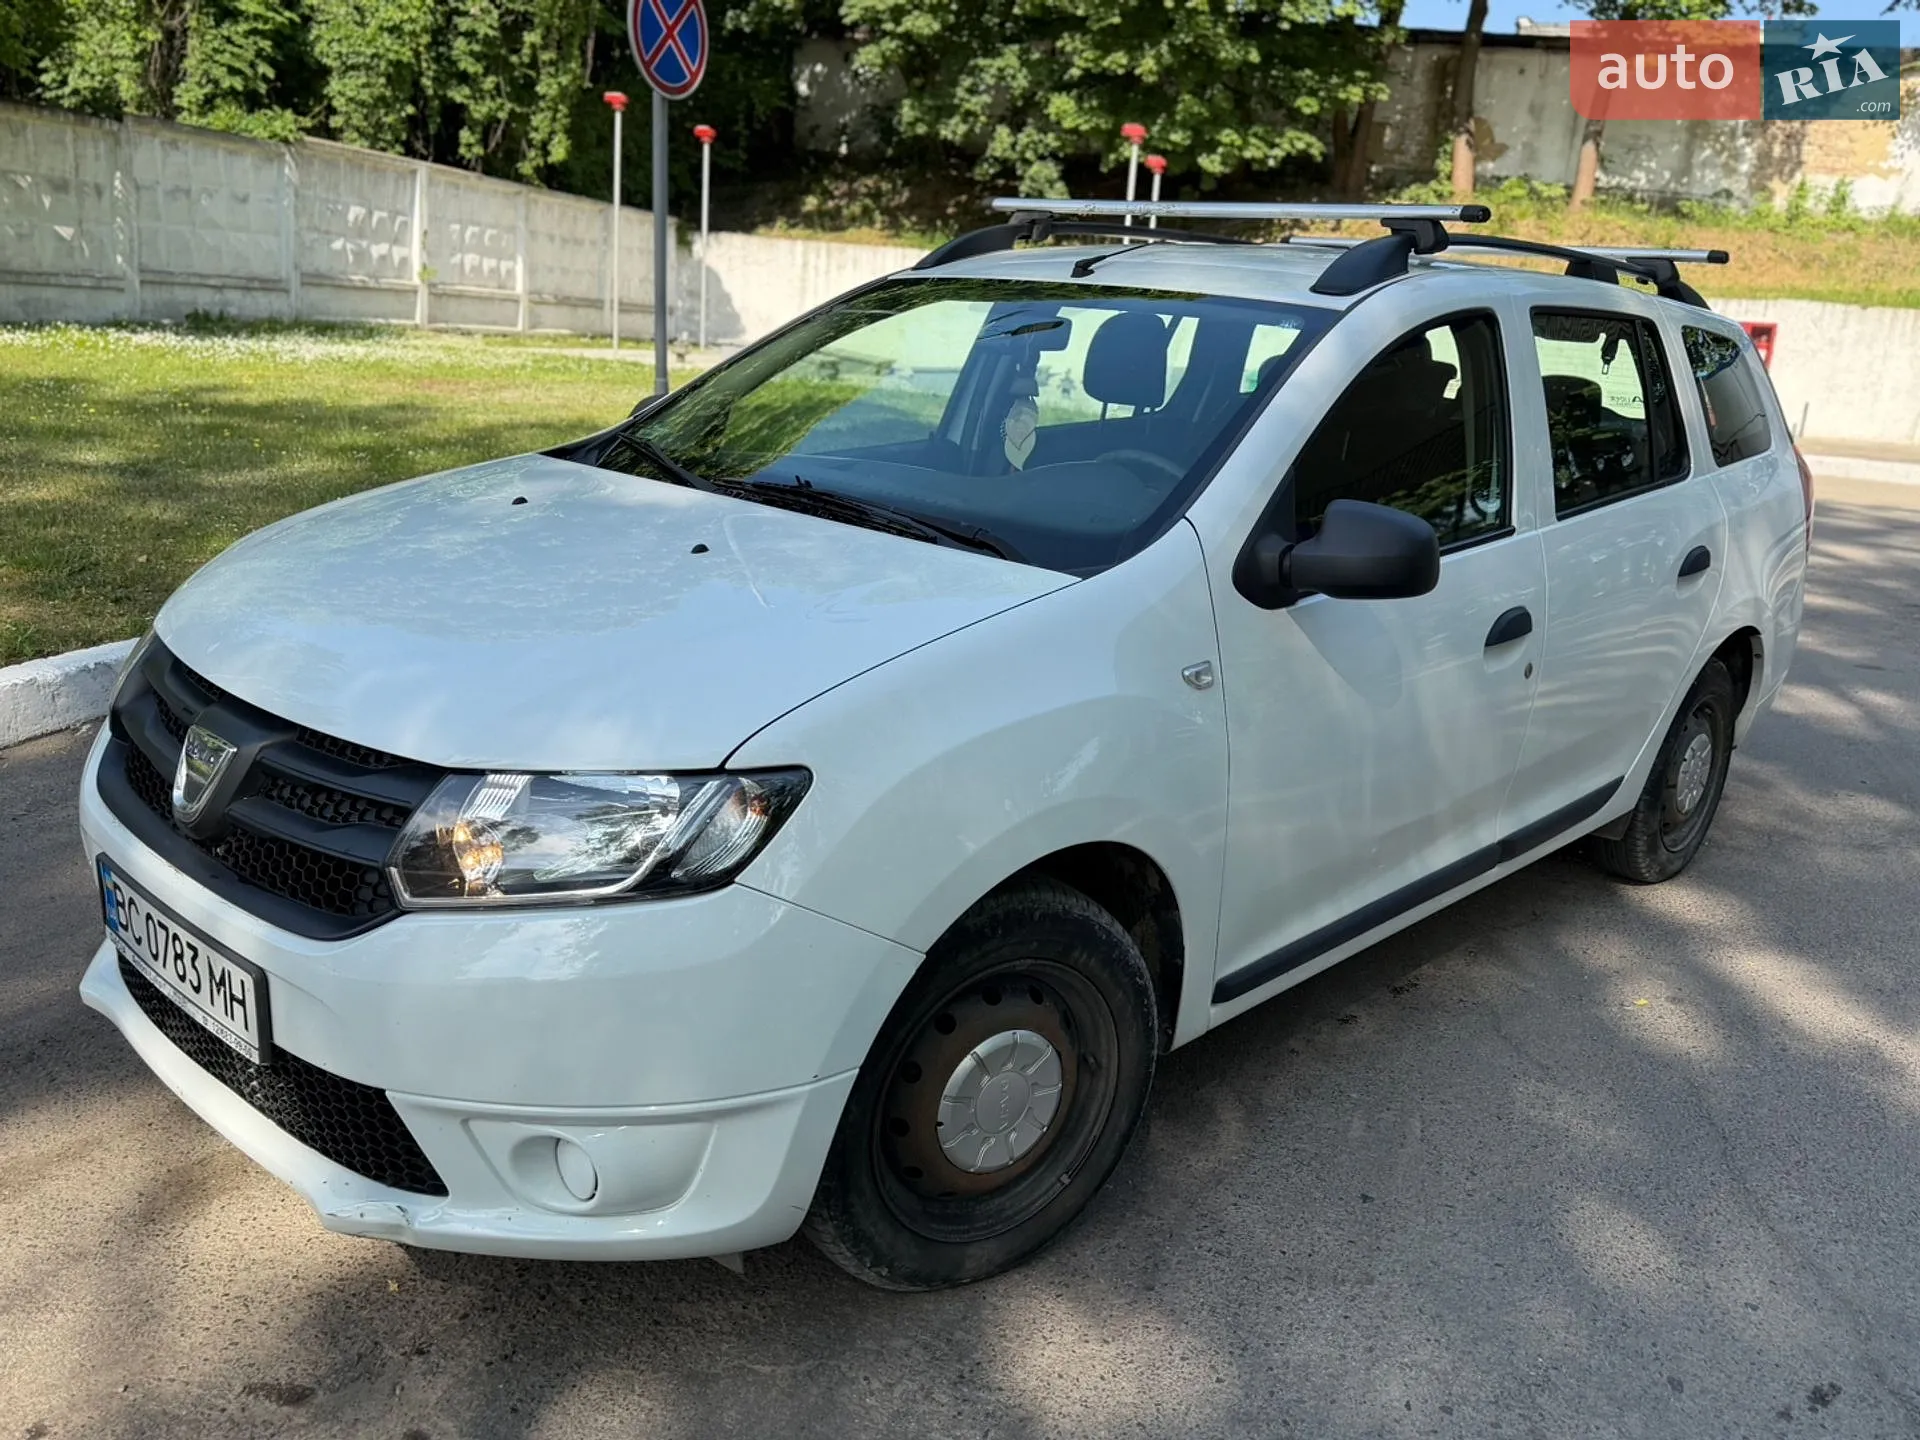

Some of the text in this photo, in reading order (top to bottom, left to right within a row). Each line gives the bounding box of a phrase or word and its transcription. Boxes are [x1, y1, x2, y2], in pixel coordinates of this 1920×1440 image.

[113, 881, 143, 946] BC
[145, 912, 202, 995] 0783
[206, 955, 250, 1033] MH
